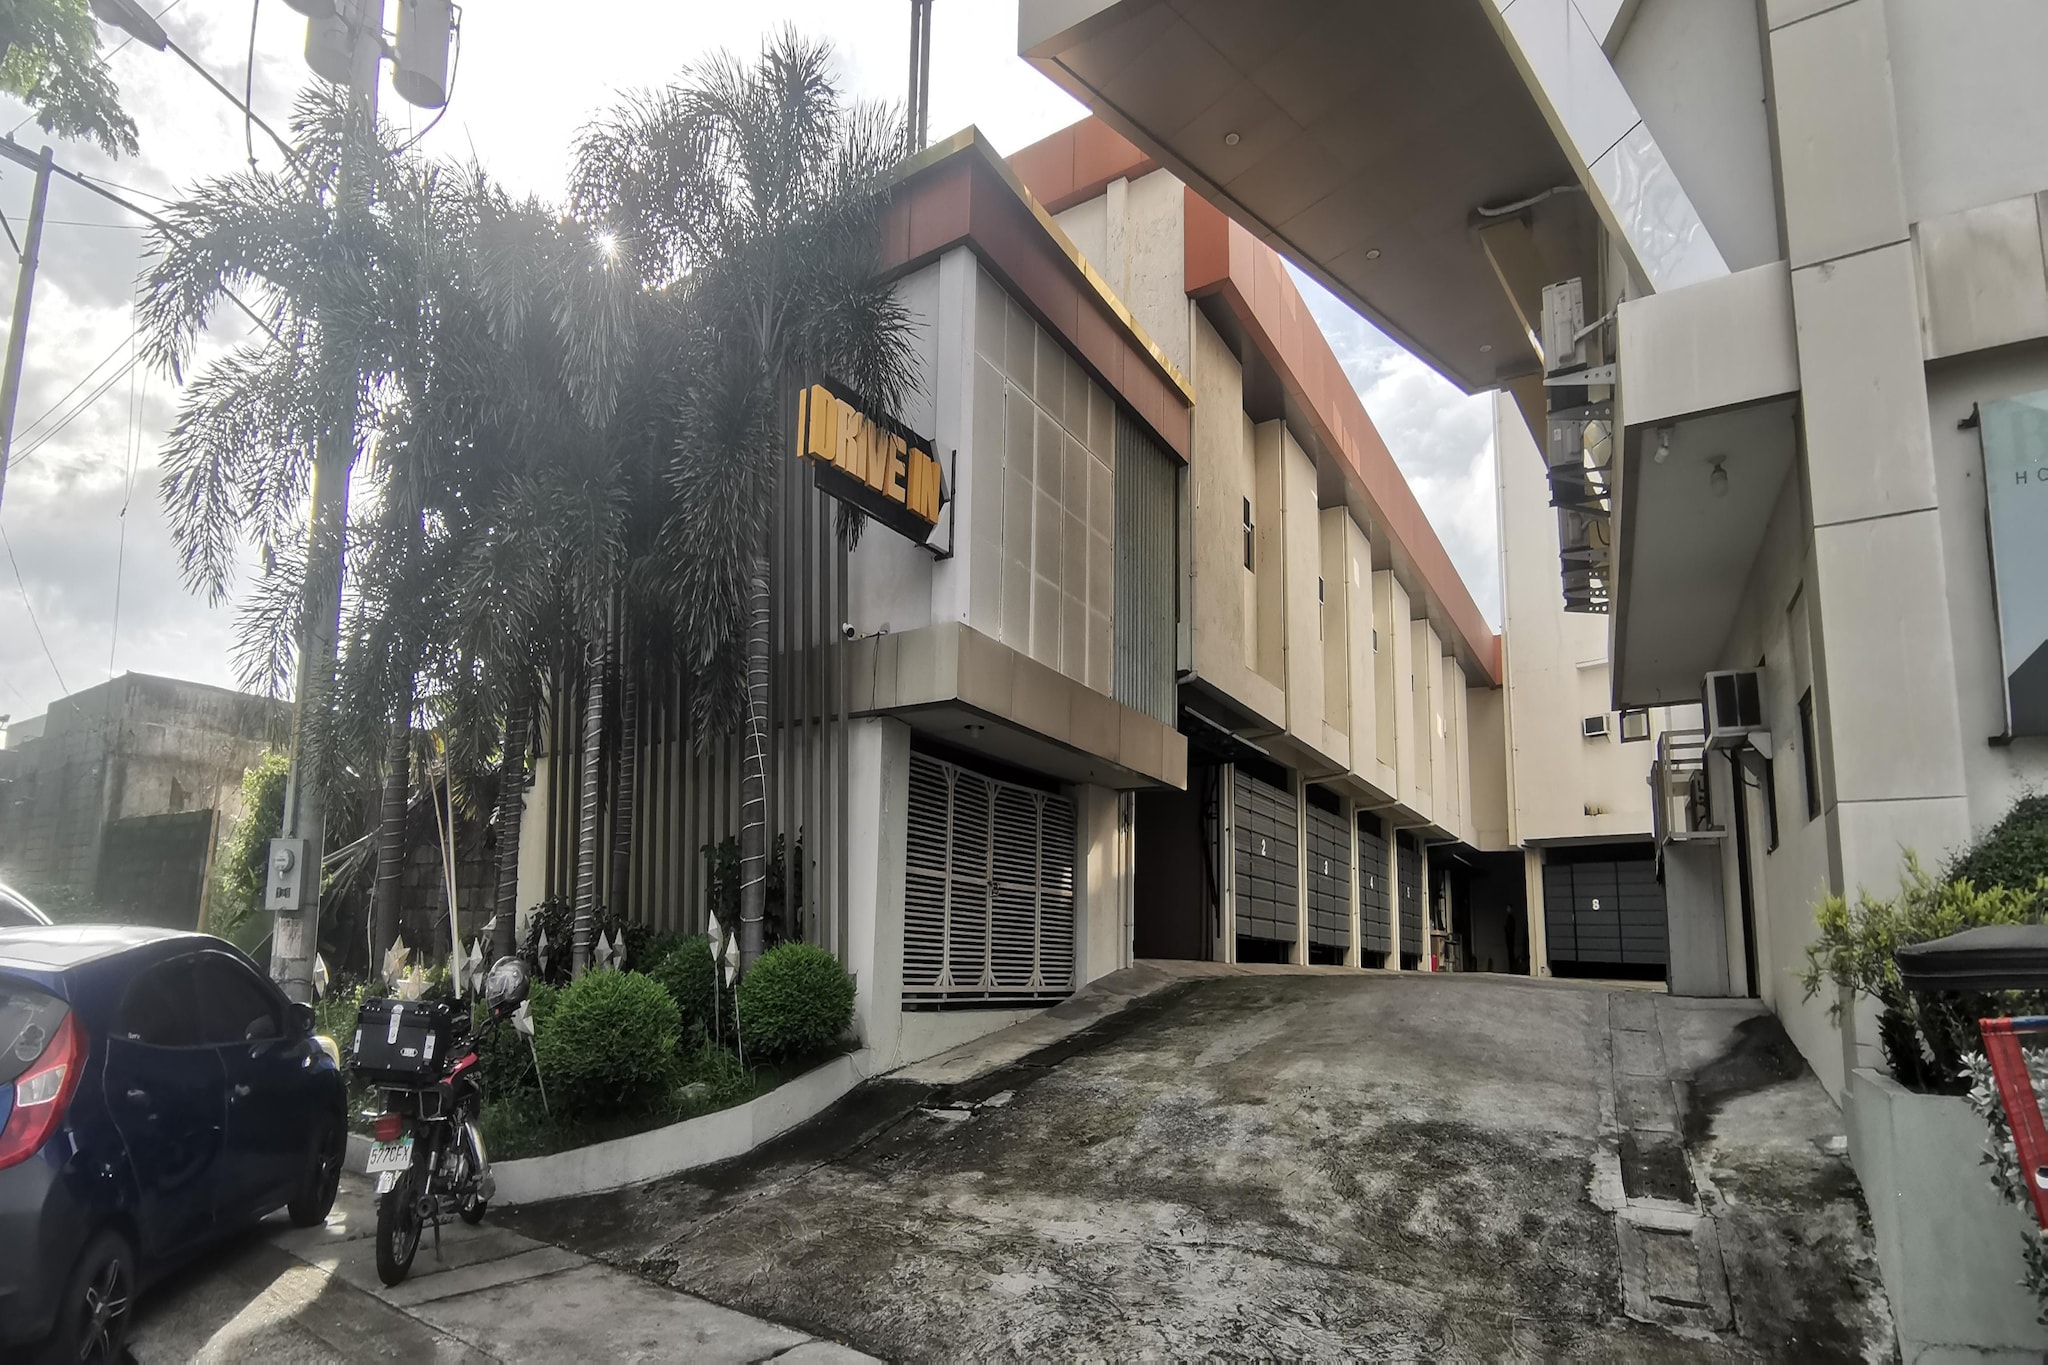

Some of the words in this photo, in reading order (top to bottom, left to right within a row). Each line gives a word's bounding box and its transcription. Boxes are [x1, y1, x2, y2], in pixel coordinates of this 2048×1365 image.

[808, 384, 907, 504] DRIVE
[907, 447, 941, 525] IN
[1261, 838, 1267, 857] 2
[1592, 898, 1600, 911] 8
